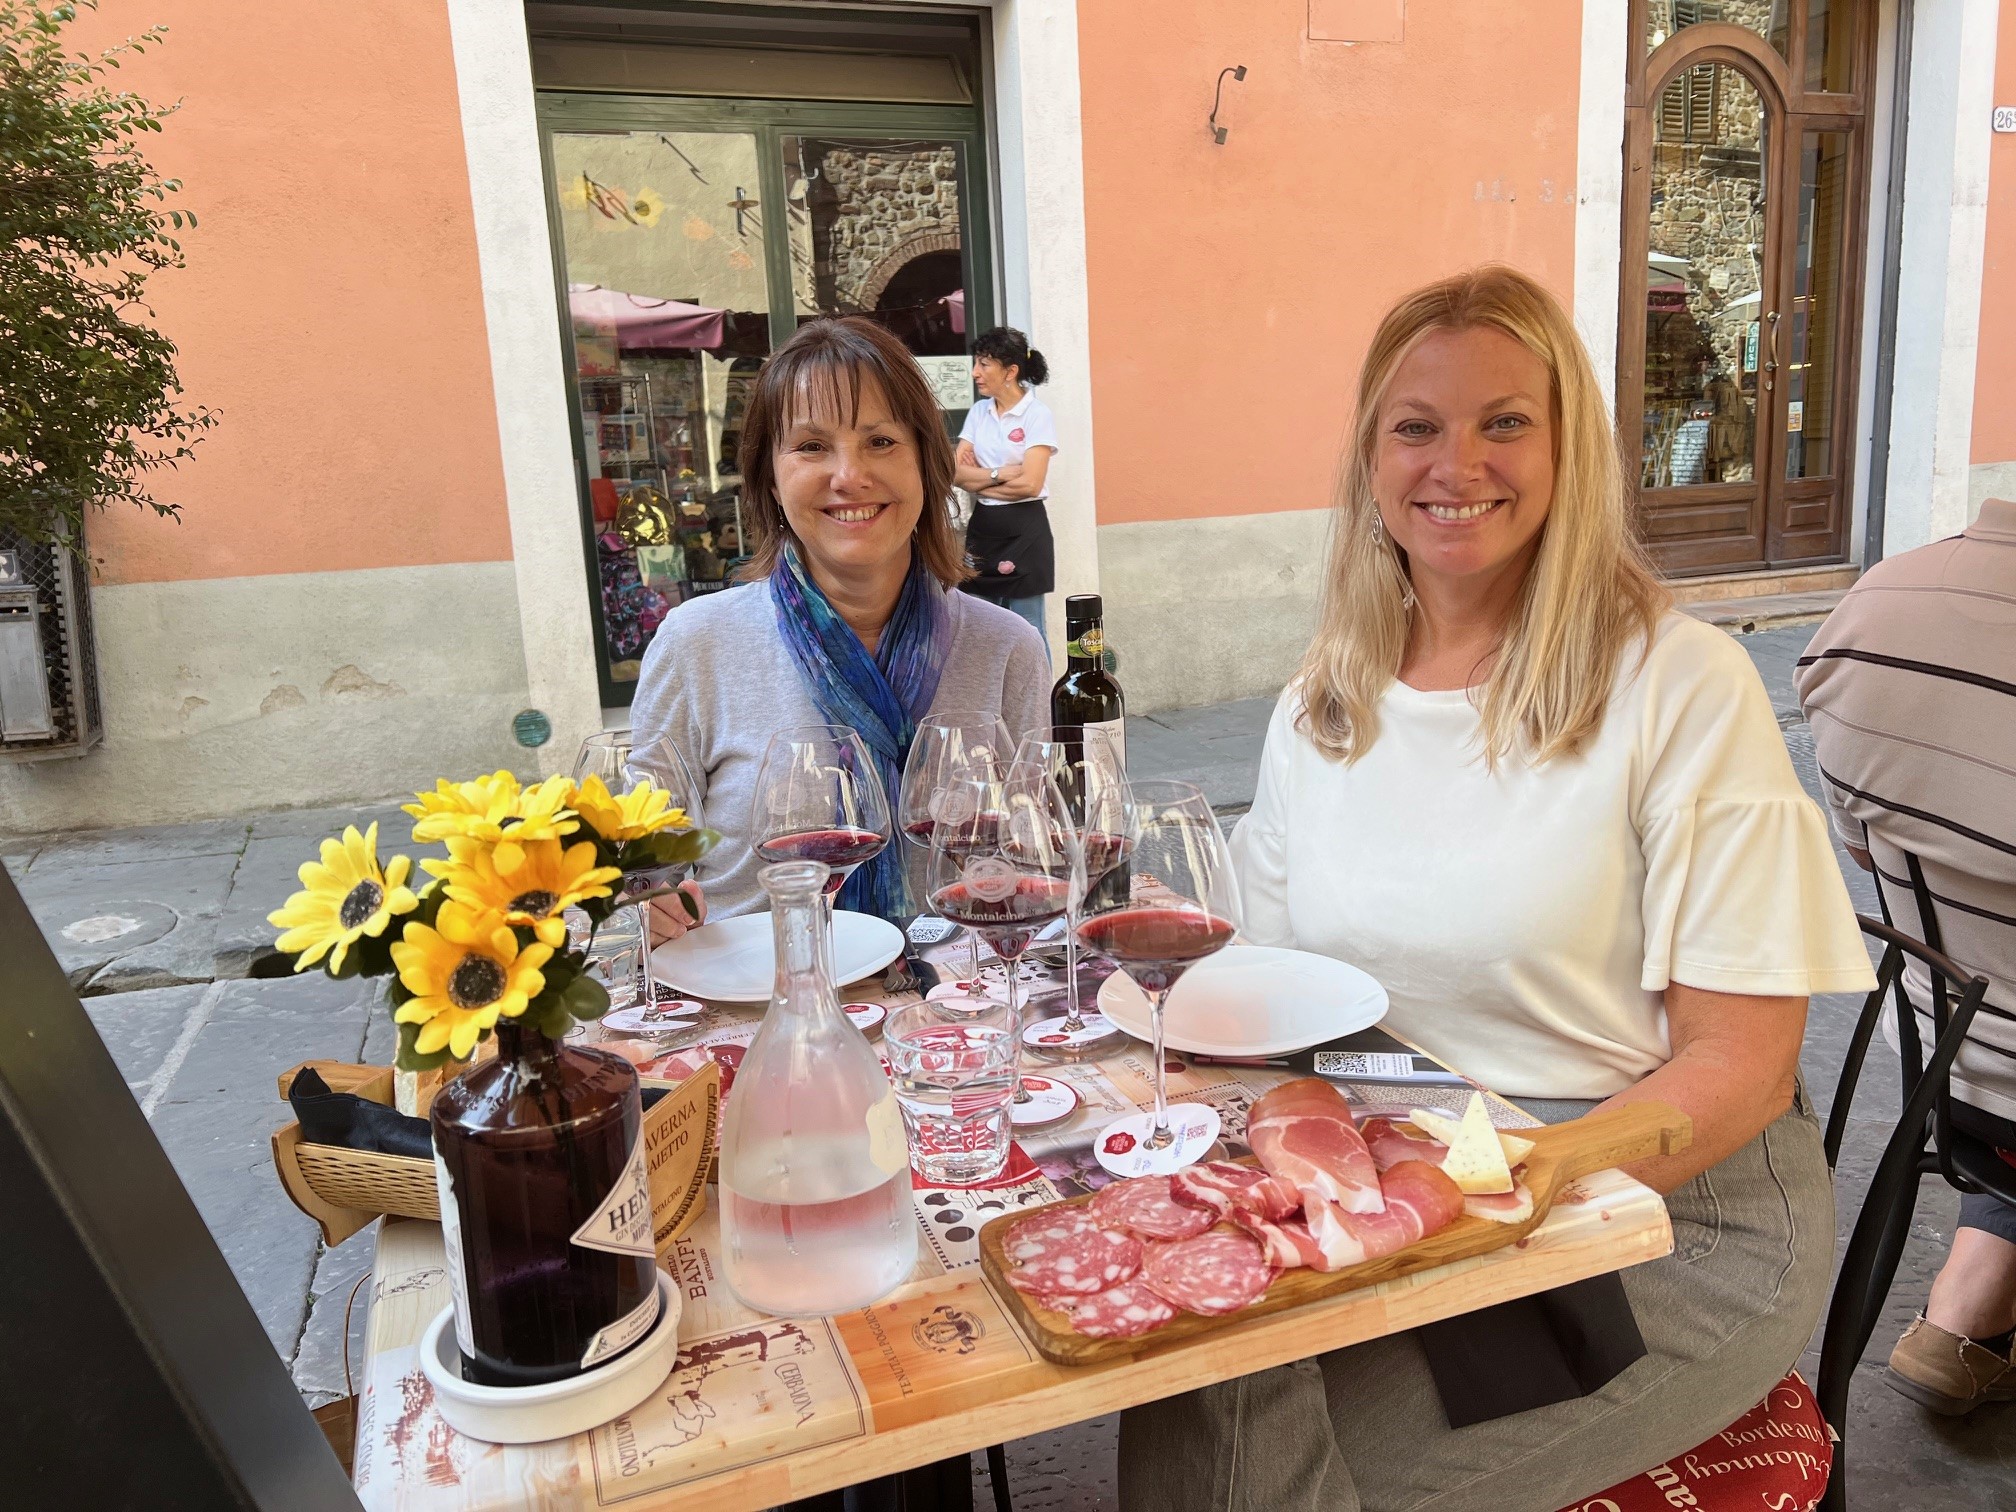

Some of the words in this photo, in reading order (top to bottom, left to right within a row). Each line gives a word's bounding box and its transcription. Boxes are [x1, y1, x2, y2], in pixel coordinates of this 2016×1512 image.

[1747, 337, 1757, 370] PUSH
[926, 833, 981, 843] Mntalcino
[959, 910, 1025, 922] Montalcino
[644, 1099, 698, 1152] AVERNA
[647, 1130, 689, 1176] AIETTO
[674, 1237, 707, 1301] BANFI
[699, 1247, 715, 1281] MONTALCINO
[885, 1357, 914, 1398] TENUTA
